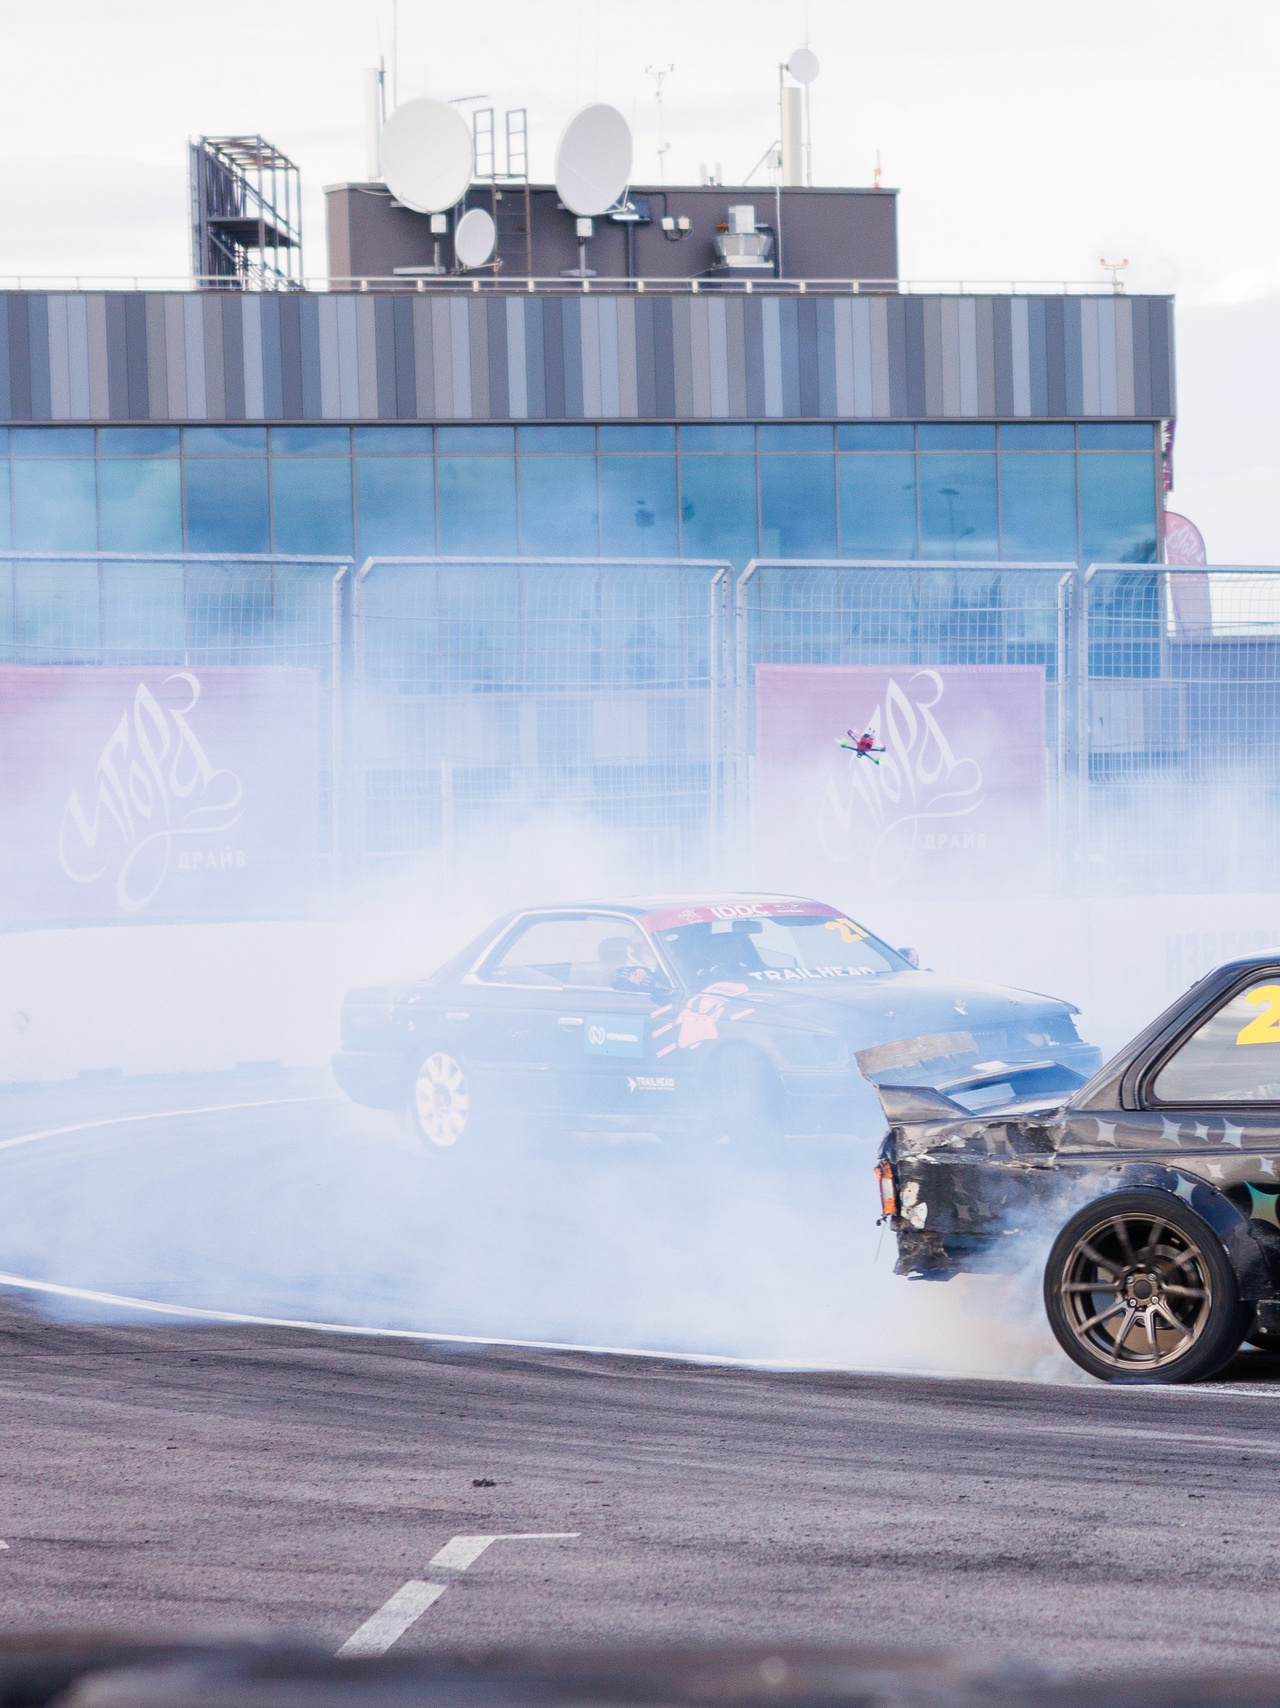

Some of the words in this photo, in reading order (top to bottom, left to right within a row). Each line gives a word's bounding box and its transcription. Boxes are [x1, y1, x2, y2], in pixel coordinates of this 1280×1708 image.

[922, 829, 987, 850] ДРАЙВ
[177, 846, 247, 870] ДРАЙВ
[825, 918, 870, 944] 21
[749, 965, 876, 981] TRAILHEAD
[636, 1077, 675, 1087] TRAILHEAD
